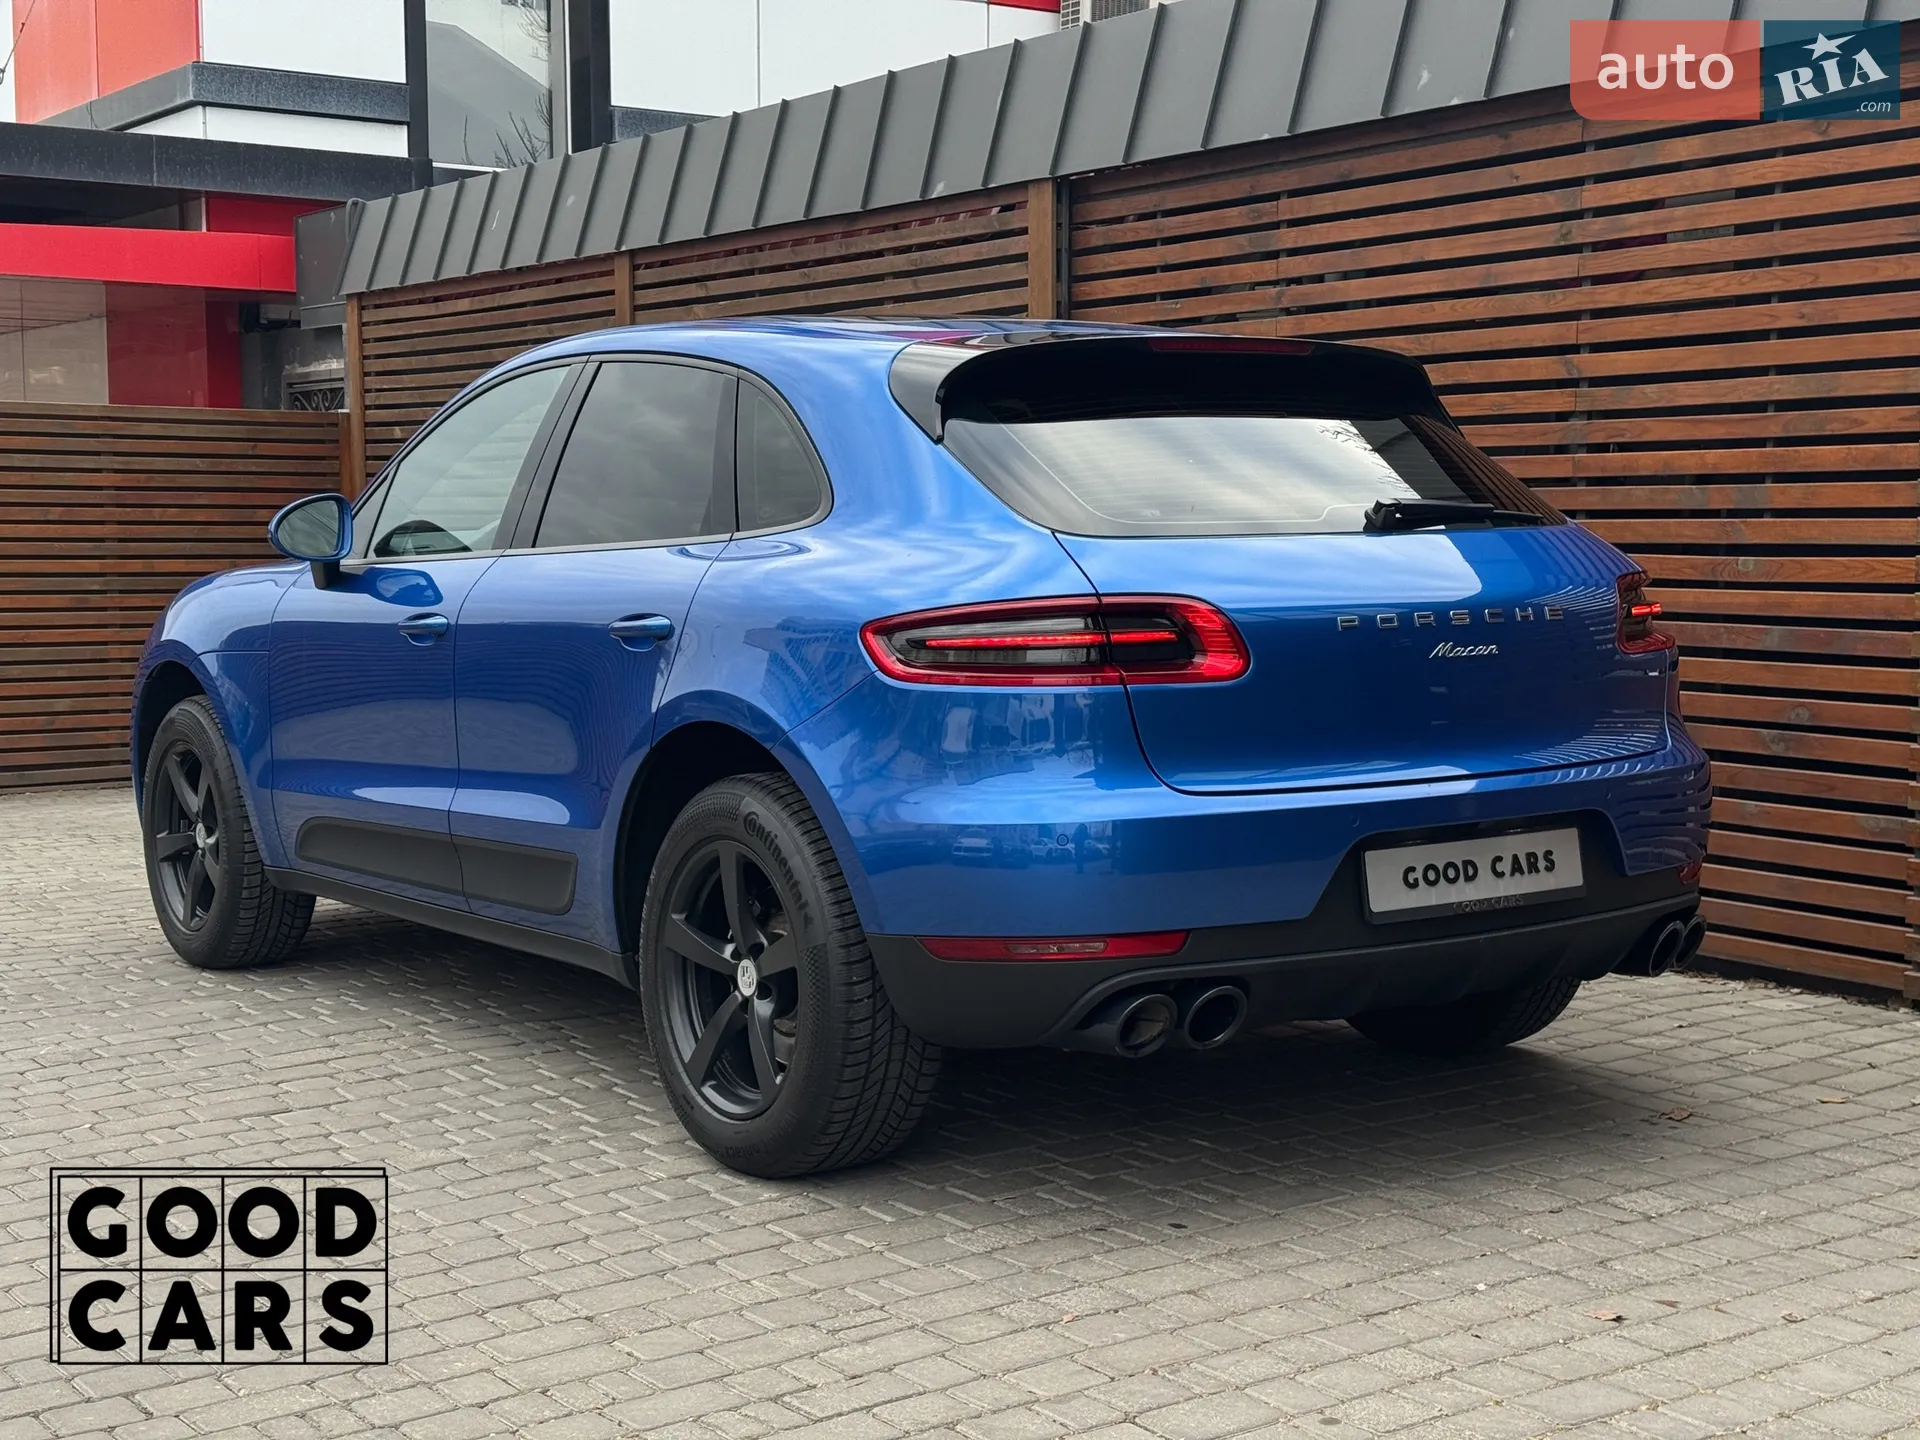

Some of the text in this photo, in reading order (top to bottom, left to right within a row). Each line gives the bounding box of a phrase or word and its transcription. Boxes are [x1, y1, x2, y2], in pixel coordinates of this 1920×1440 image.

[1337, 605, 1564, 631] PORSCHE
[1428, 641, 1499, 659] Macan
[1402, 849, 1556, 890] GOOD CARS
